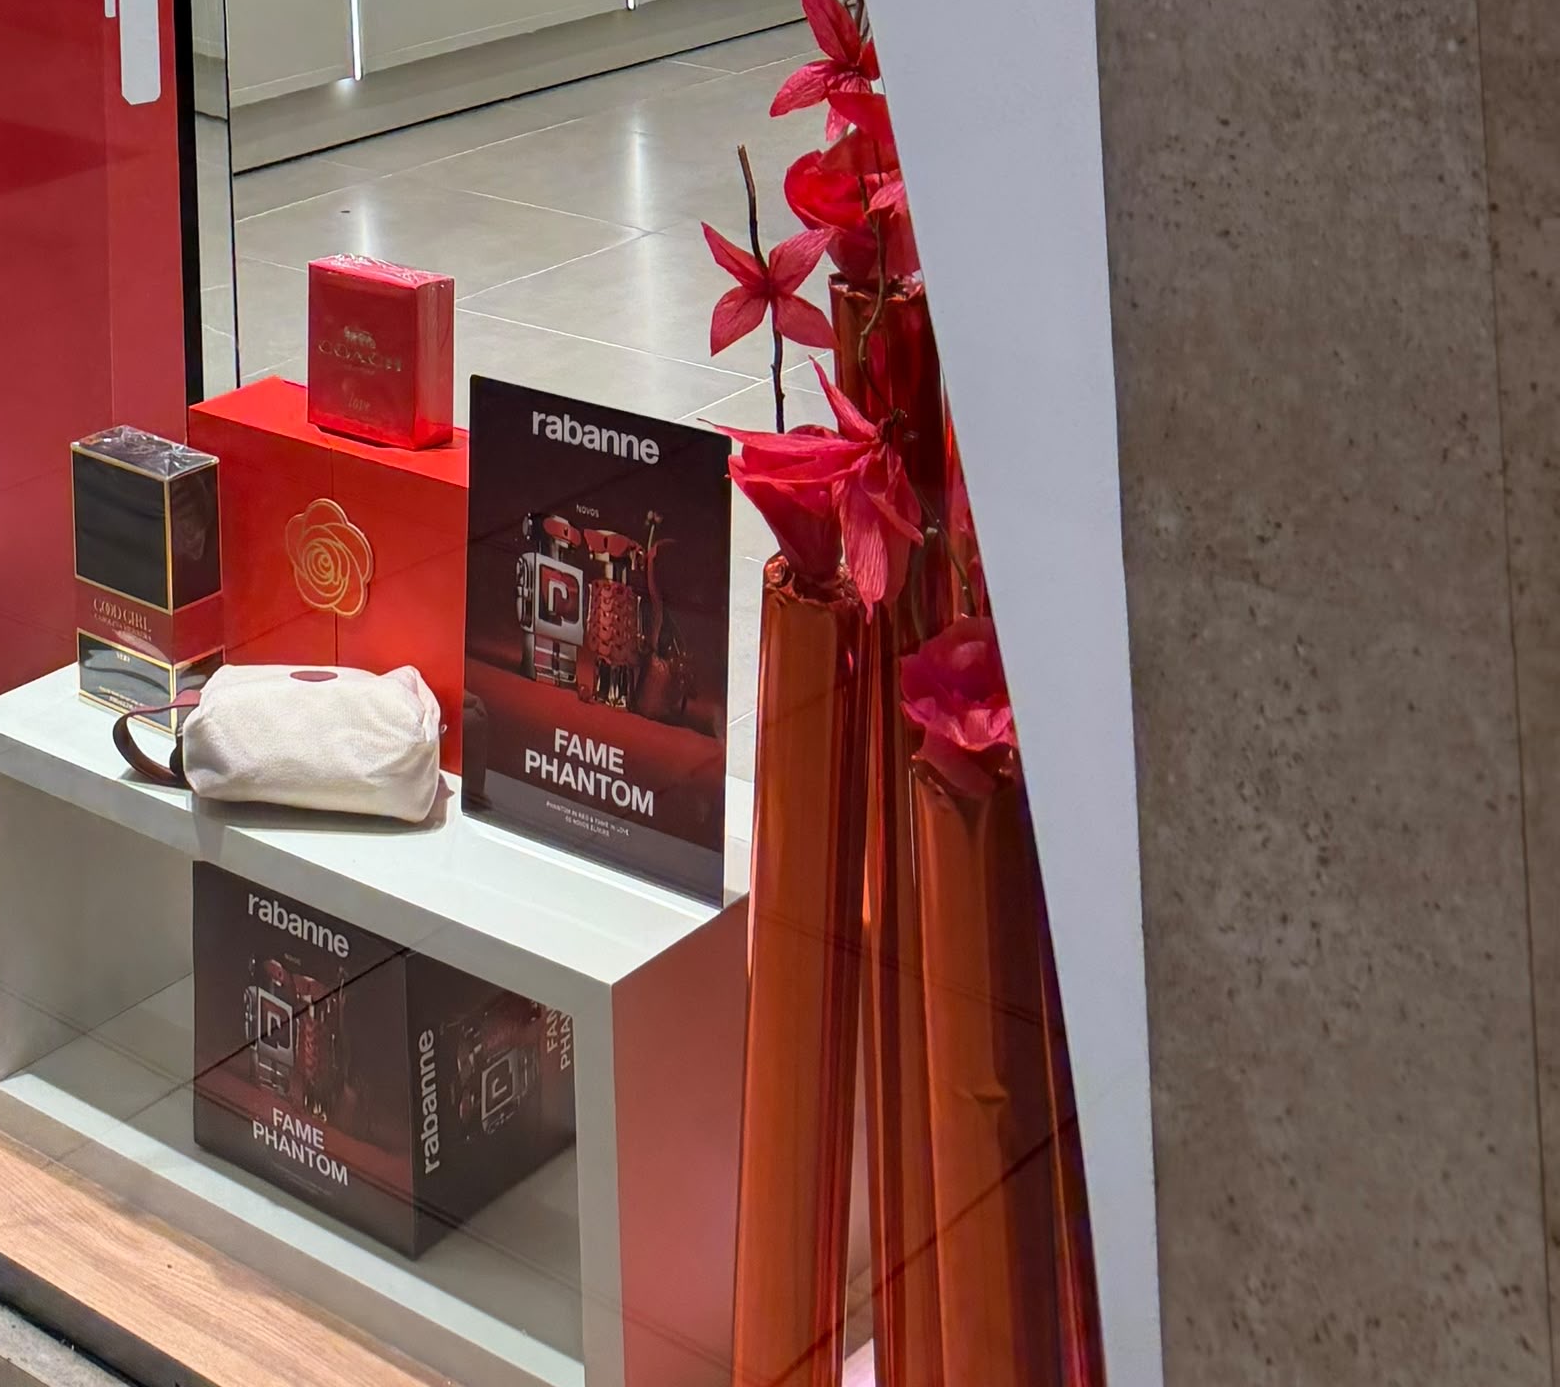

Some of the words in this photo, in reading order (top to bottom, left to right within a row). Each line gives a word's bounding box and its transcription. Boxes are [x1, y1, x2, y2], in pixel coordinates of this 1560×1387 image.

[531, 408, 660, 466] rabanne
[575, 503, 600, 518] NOVOS
[524, 747, 654, 818] PHANTOM
[553, 727, 625, 776] FAME
[247, 892, 350, 959] rabanne
[272, 1106, 324, 1151] FAME
[420, 1028, 441, 1175] rabanne
[252, 1119, 349, 1187] PHANTOM
